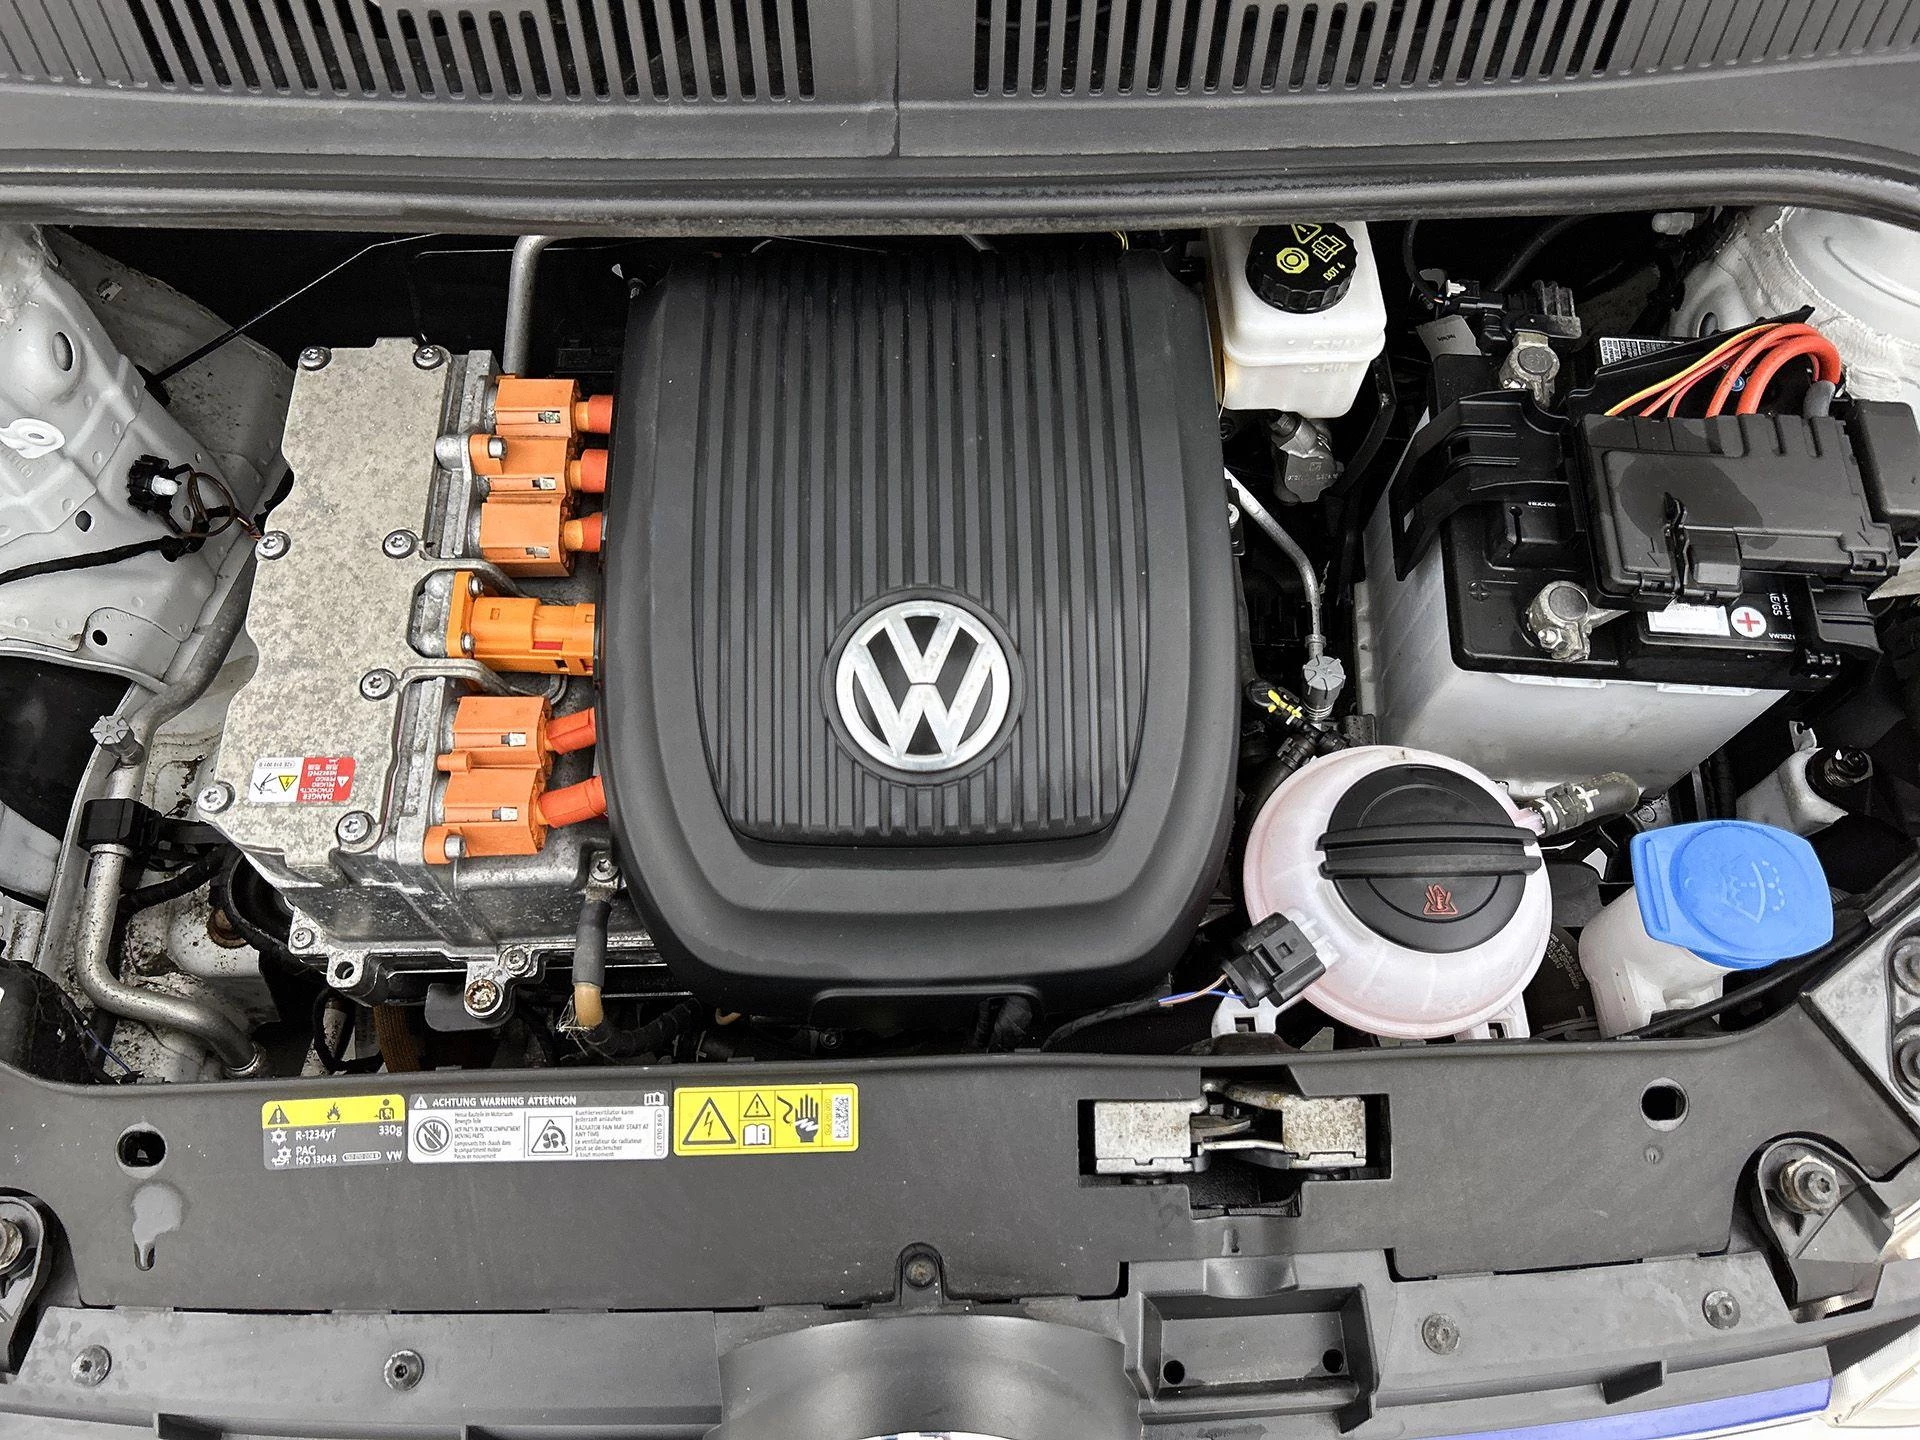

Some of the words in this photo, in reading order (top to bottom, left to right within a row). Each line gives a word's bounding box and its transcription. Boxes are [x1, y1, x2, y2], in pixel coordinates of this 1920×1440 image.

[1323, 266, 1339, 281] DOT
[1323, 363, 1349, 372] MIN
[836, 600, 1010, 771] VW
[432, 1097, 479, 1107] ACHTUNG
[480, 1096, 524, 1106] WARNING
[528, 1095, 577, 1106] ATTENTION
[295, 1128, 336, 1142] R-1234yf
[378, 1125, 403, 1137] 330g
[295, 1146, 316, 1156] PAG
[386, 1150, 403, 1161] VW
[295, 1155, 311, 1165] ISO
[313, 1154, 337, 1164] 13043
